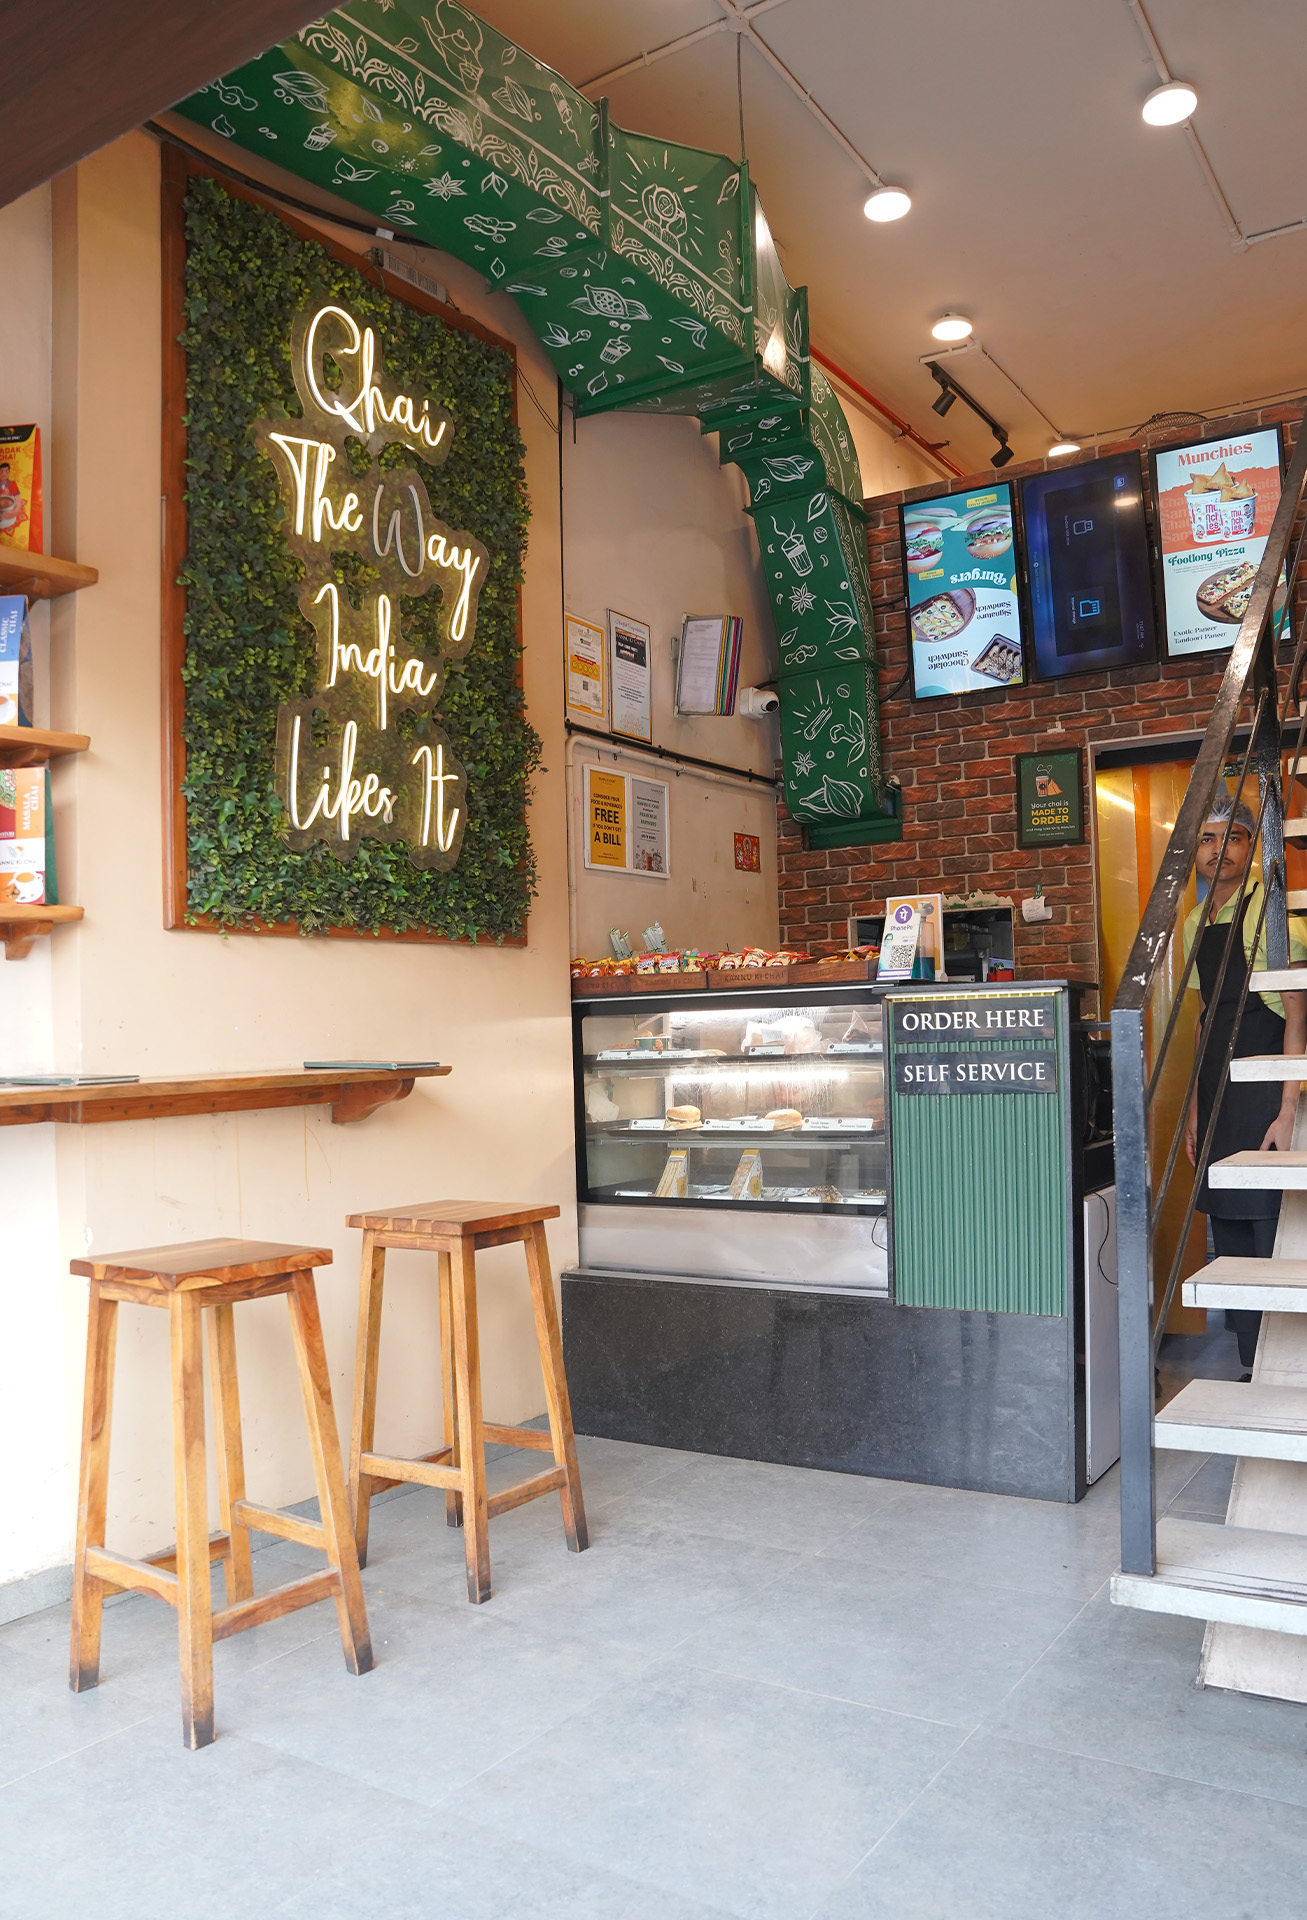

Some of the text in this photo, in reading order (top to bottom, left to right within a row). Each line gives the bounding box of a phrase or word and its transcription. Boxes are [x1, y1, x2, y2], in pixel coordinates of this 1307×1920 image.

[303, 305, 446, 447] Chai
[1178, 441, 1253, 467] Munchies
[269, 431, 480, 641] The Way
[1215, 547, 1245, 557] Pizza
[950, 568, 1006, 585] Burgers
[976, 601, 1012, 613] Sandwich
[977, 609, 1012, 619] Signature
[9, 610, 18, 634] CHAI
[0, 617, 9, 653] CLASSIC
[1173, 628, 1193, 636] Exotic
[1174, 631, 1227, 644] Tandoori Paneer
[313, 583, 437, 730] India
[928, 650, 969, 661] Sandwich
[928, 659, 969, 670] Chocolate
[289, 715, 460, 852] Likes It
[30, 785, 39, 811] CHAI
[1048, 800, 1062, 808] chai
[23, 793, 31, 830] MASALA
[594, 807, 619, 824] FREE
[1032, 808, 1055, 816] MADE
[1032, 815, 1069, 825] ORDER
[594, 831, 621, 846] A BILL
[890, 924, 913, 932] PhonePe
[724, 974, 751, 982] KANNU
[764, 972, 784, 980] CHAI
[902, 1009, 1044, 1031] ORDER HERE
[904, 1062, 1046, 1083] SELF SERVICE
